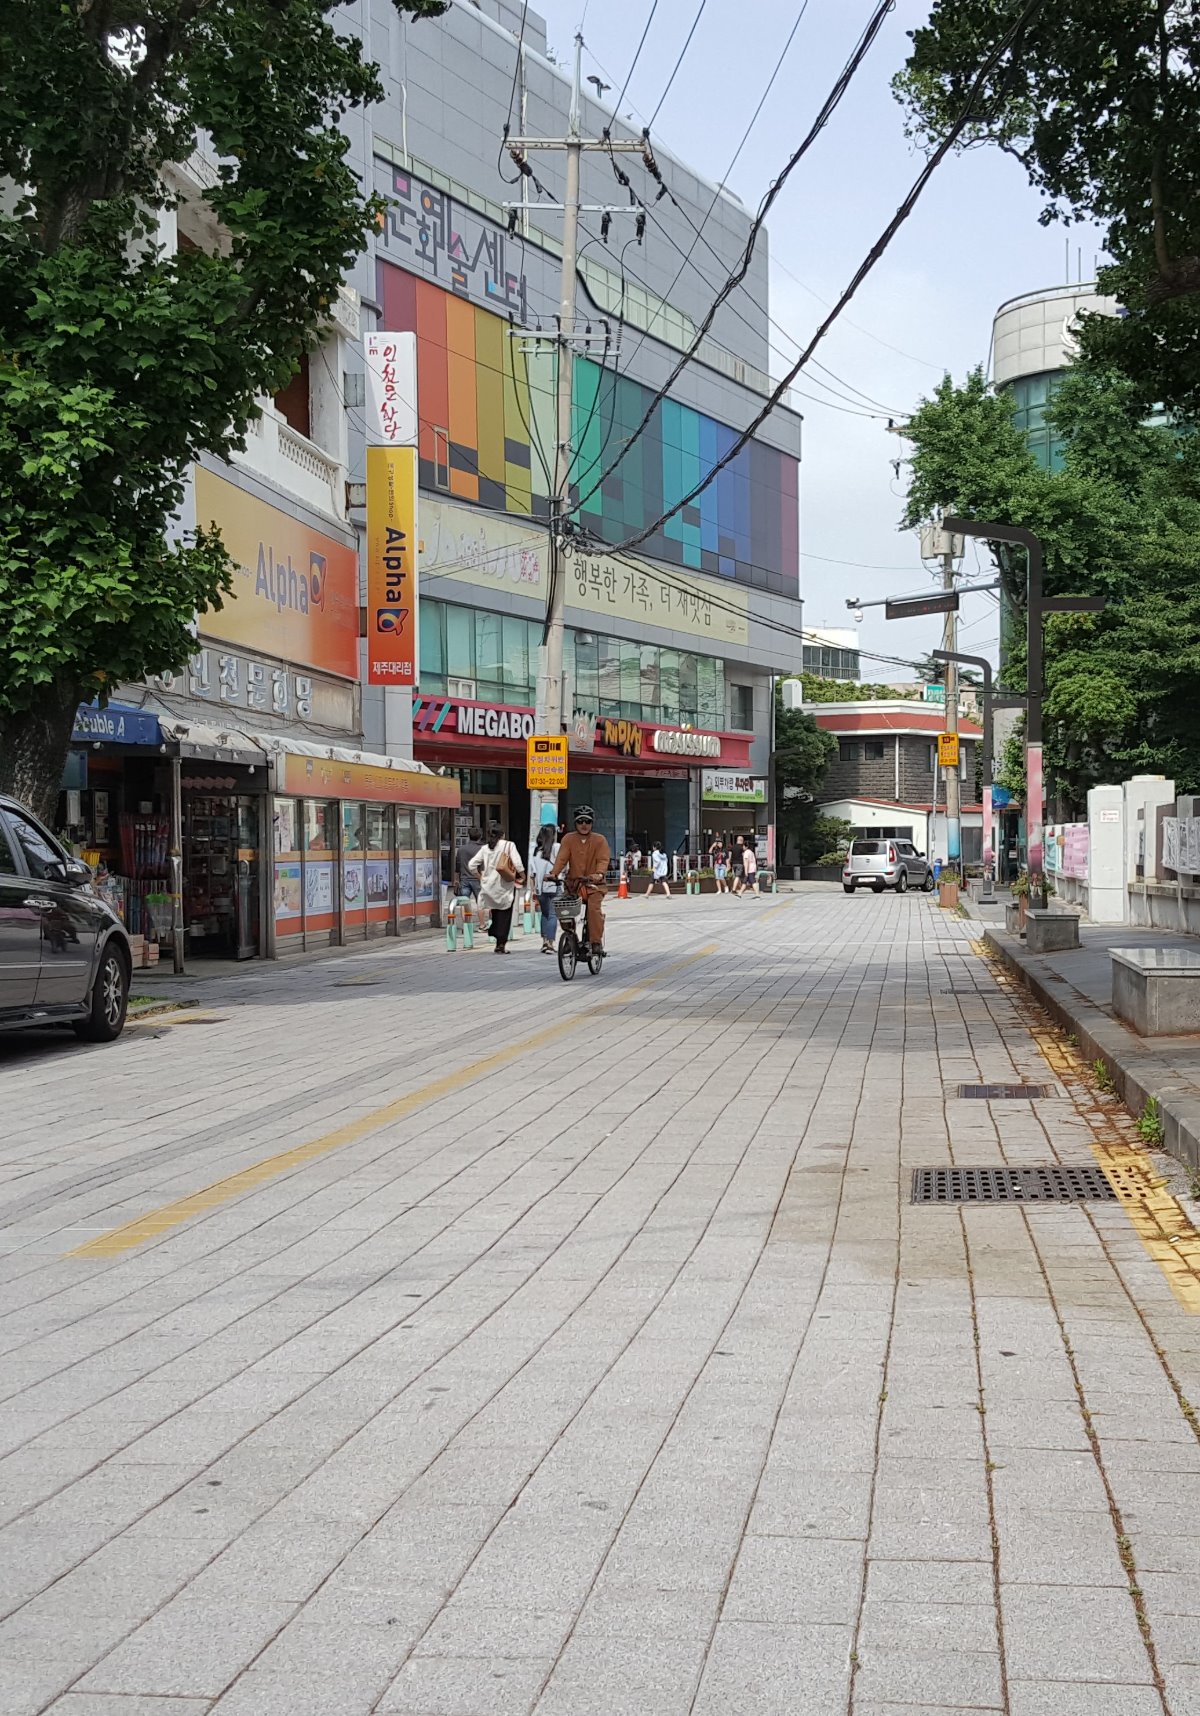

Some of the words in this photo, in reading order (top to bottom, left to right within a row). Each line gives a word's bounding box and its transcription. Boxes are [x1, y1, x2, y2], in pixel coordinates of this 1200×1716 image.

[256, 541, 309, 615] Alpha
[383, 527, 406, 603] Alpha
[573, 559, 617, 603] 행복한
[623, 573, 653, 611] 가족,
[660, 584, 671, 612] 더
[189, 650, 312, 721] 인천문화당
[372, 661, 411, 676] 제주대리점
[117, 716, 125, 737] A
[458, 706, 535, 740] MEGABO
